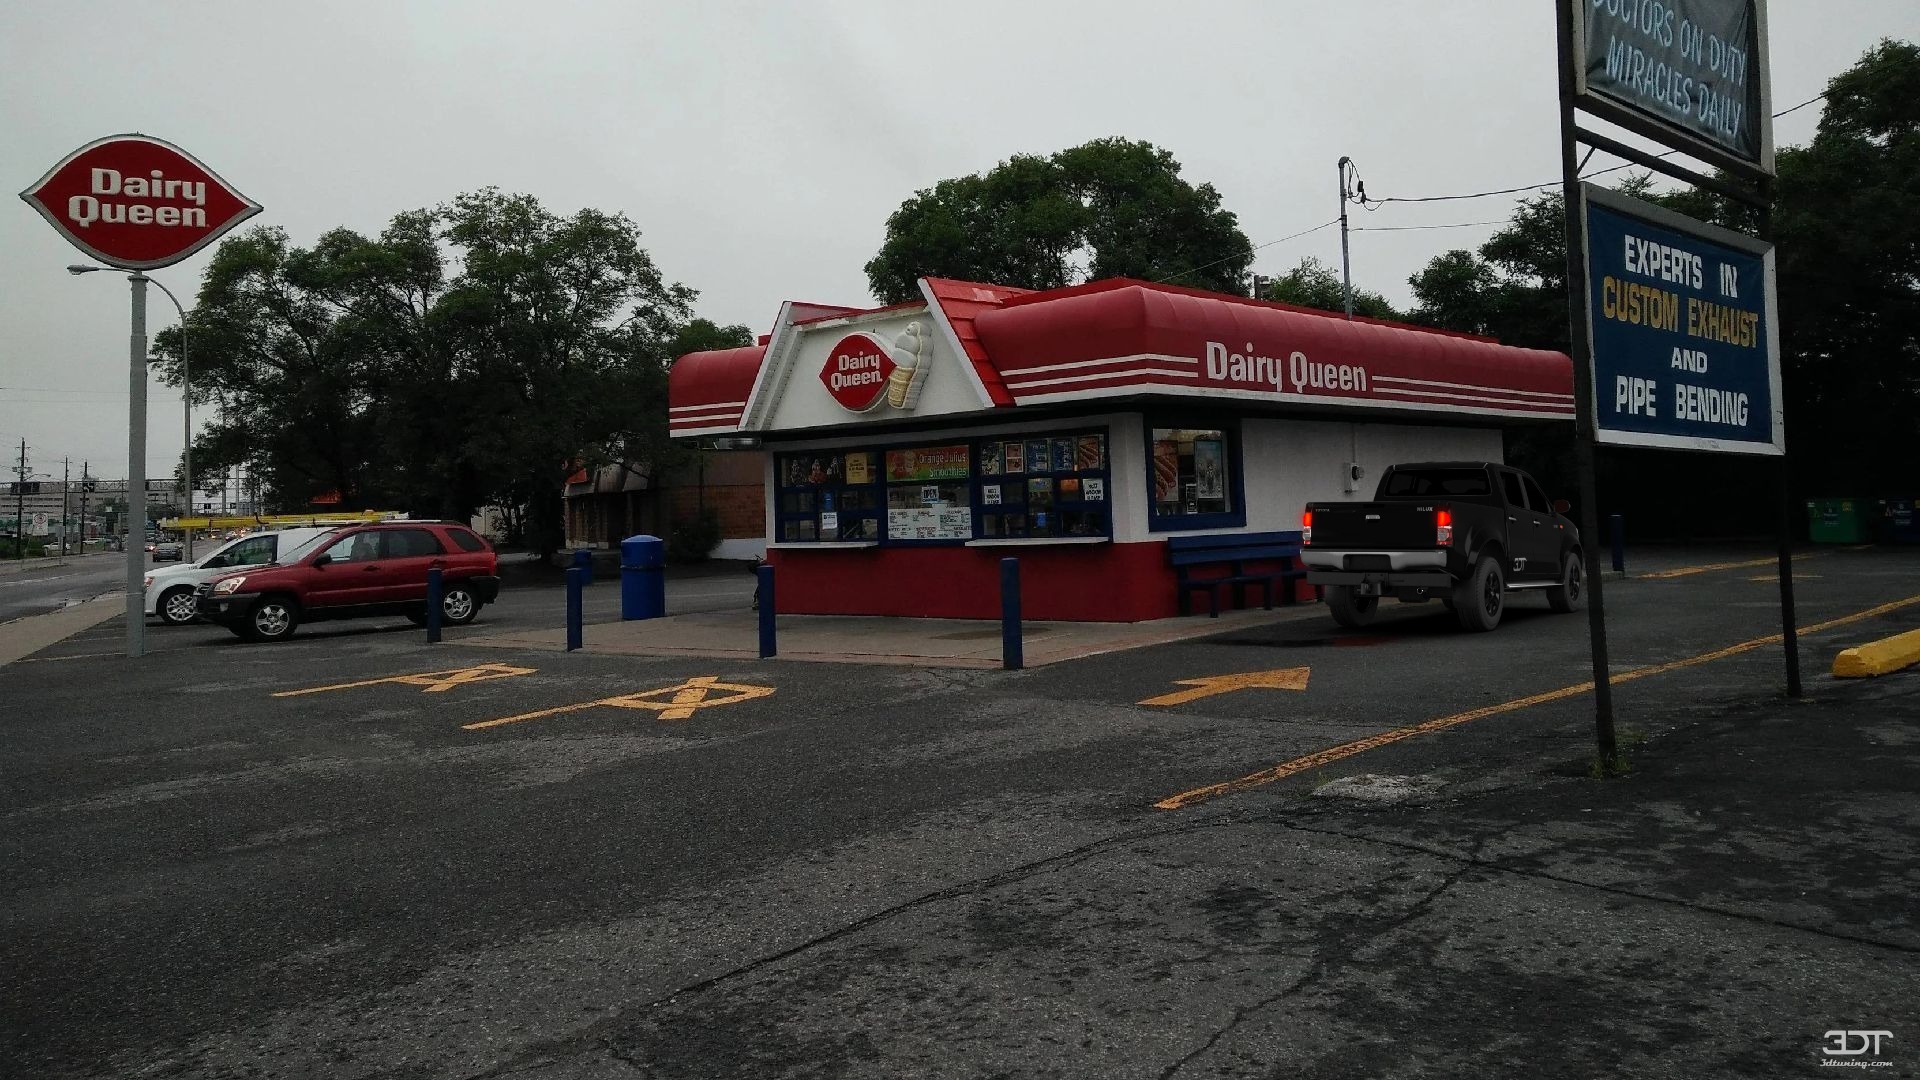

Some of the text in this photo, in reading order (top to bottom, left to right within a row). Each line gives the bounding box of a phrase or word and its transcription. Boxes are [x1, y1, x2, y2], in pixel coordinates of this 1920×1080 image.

[1594, 0, 1746, 87] CTORS ON DUTY
[1606, 34, 1742, 138] MIRACLES DAILY
[91, 167, 206, 206] Dairy
[68, 195, 206, 228] Queen
[1624, 234, 1738, 298] EXPERTS IN
[1603, 275, 1759, 348] CUSTOM EXHAUST
[838, 351, 880, 371] Dairy
[1206, 341, 1367, 394] Dairy Queen
[1671, 347, 1708, 374] AND
[830, 370, 881, 392] Queen
[1616, 375, 1749, 427] PIPE BENDING
[919, 451, 966, 466] Orange Julius
[929, 465, 967, 477] Smoothies
[1513, 557, 1528, 572] 3DT
